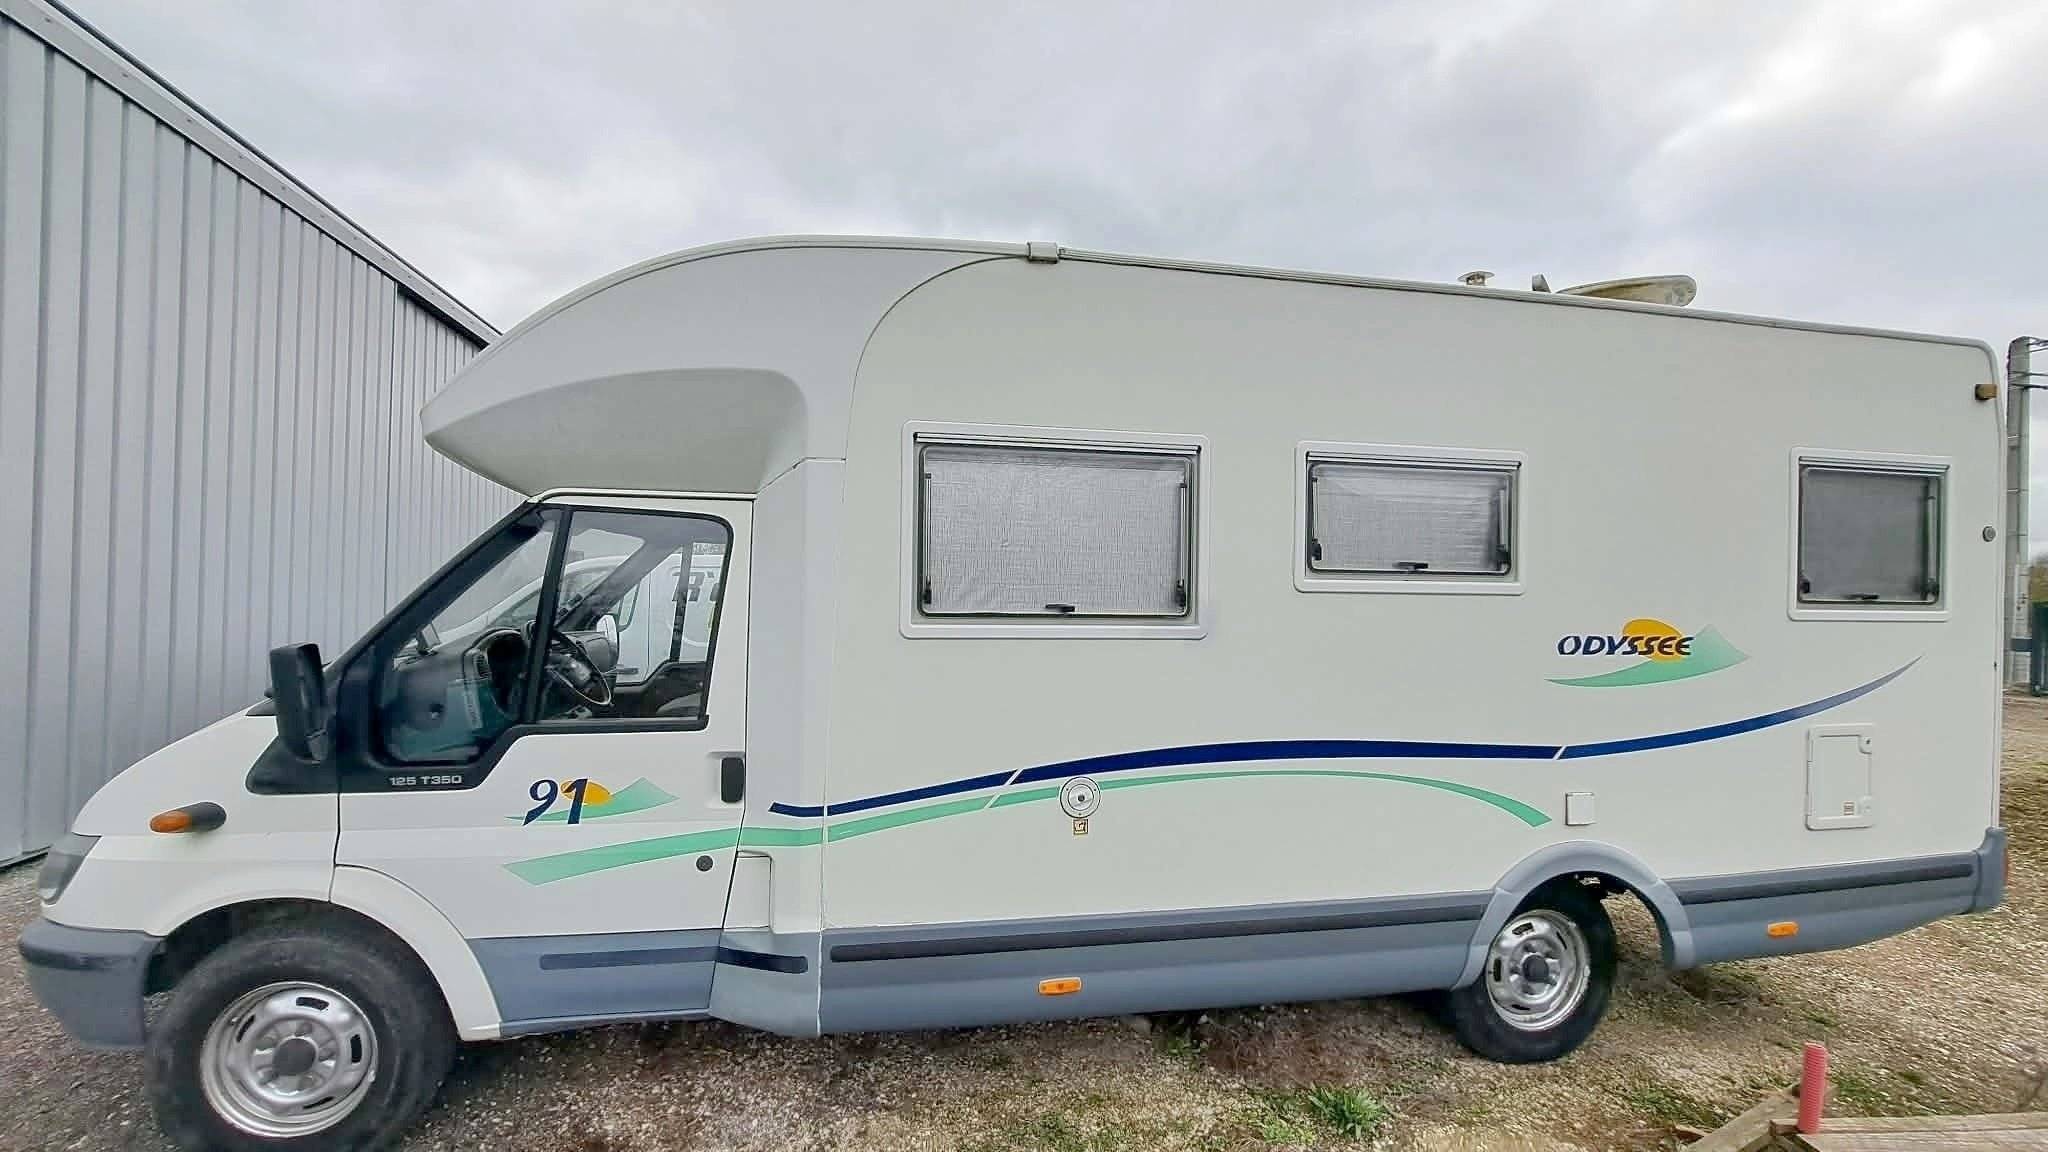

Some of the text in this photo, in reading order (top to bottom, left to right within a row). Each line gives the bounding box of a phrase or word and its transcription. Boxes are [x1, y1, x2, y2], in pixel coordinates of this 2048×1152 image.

[1557, 635, 1695, 655] ODYSSEE
[389, 775, 462, 786] 125 T350
[523, 778, 588, 826] 91
